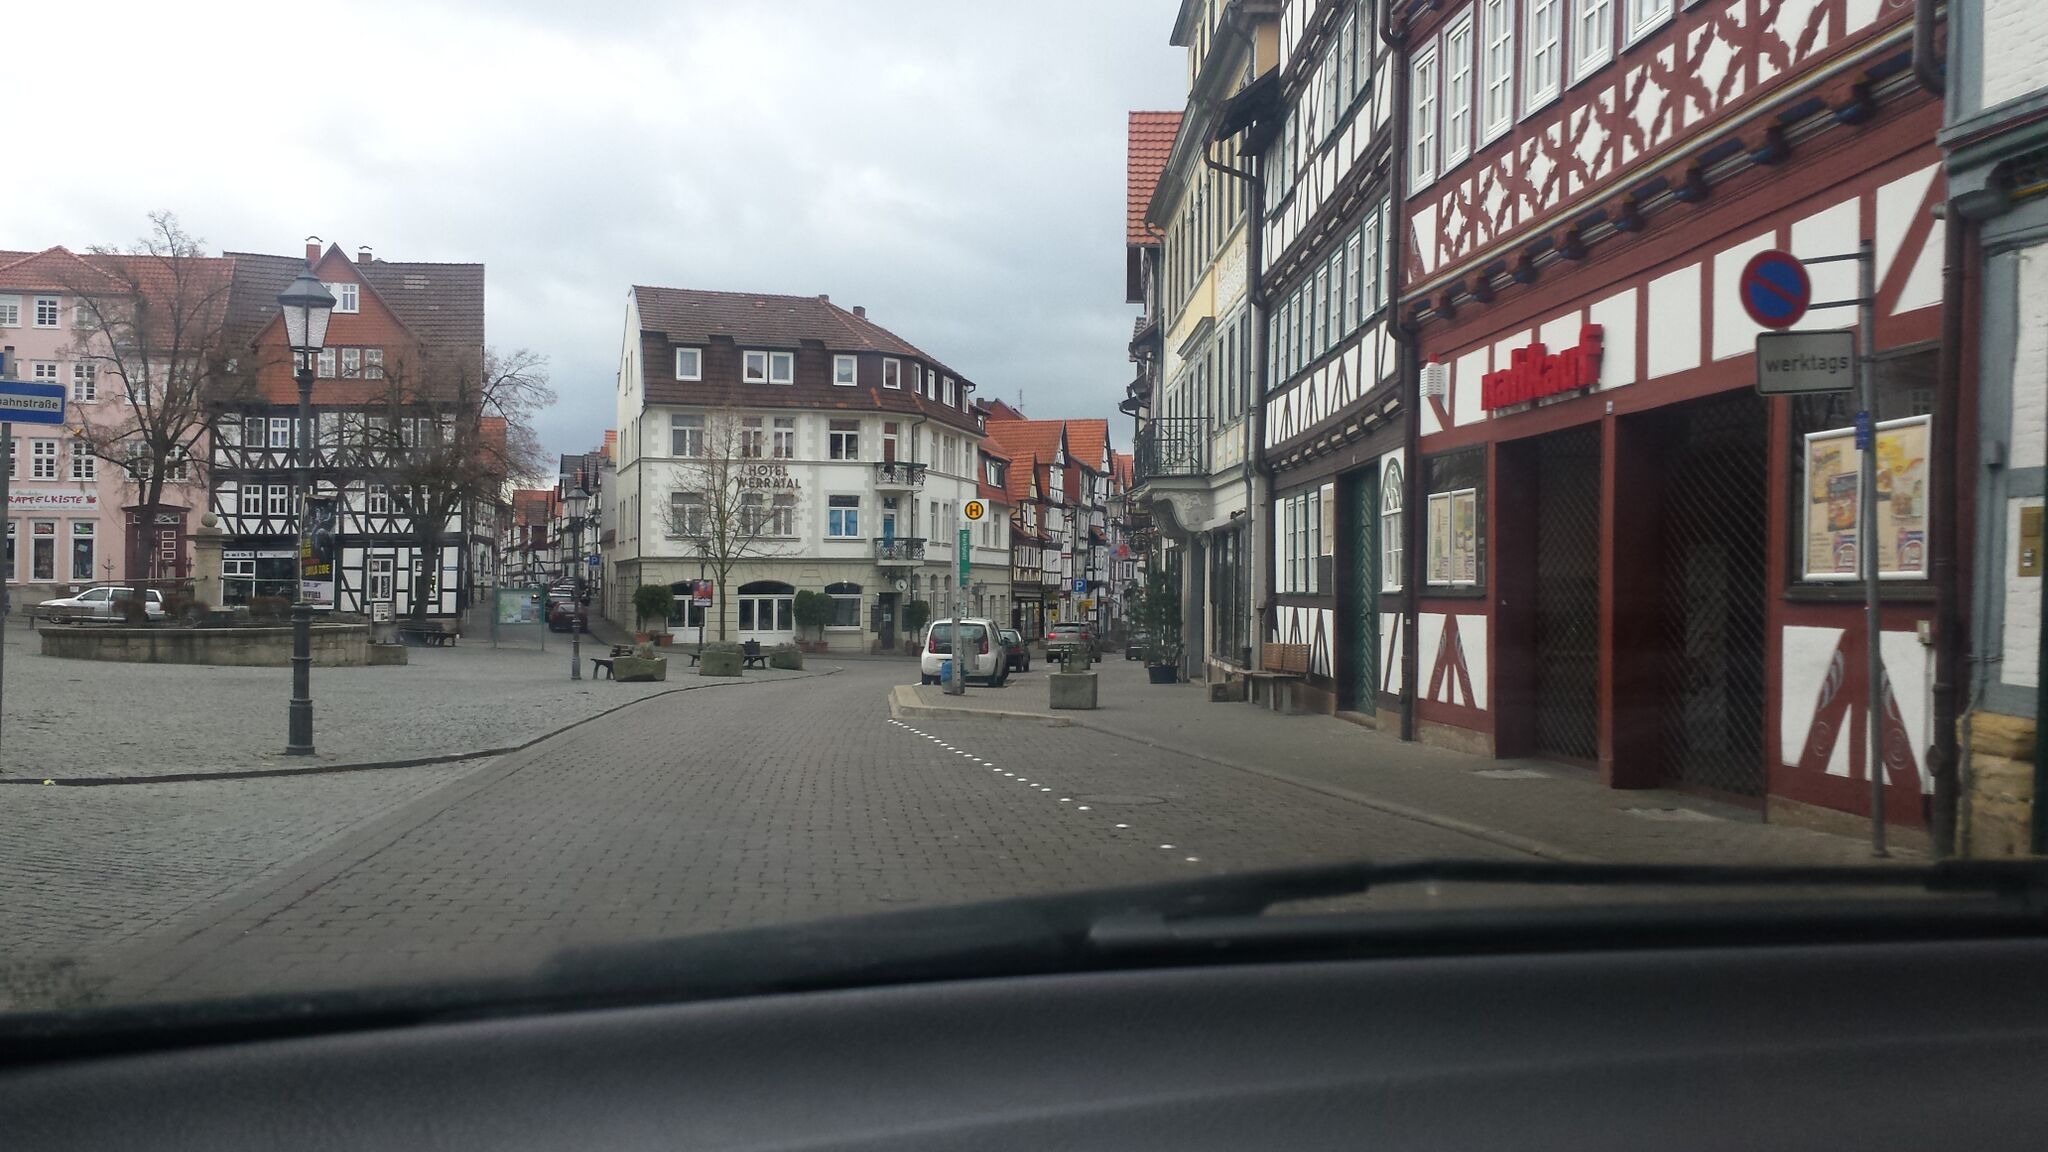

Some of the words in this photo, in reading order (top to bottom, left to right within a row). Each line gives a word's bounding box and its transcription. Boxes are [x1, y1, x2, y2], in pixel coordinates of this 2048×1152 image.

[1764, 354, 1849, 375] werktags
[748, 465, 789, 476] HOTEL
[740, 477, 802, 489] WERRATAL
[969, 504, 979, 516] H
[1076, 580, 1084, 591] P
